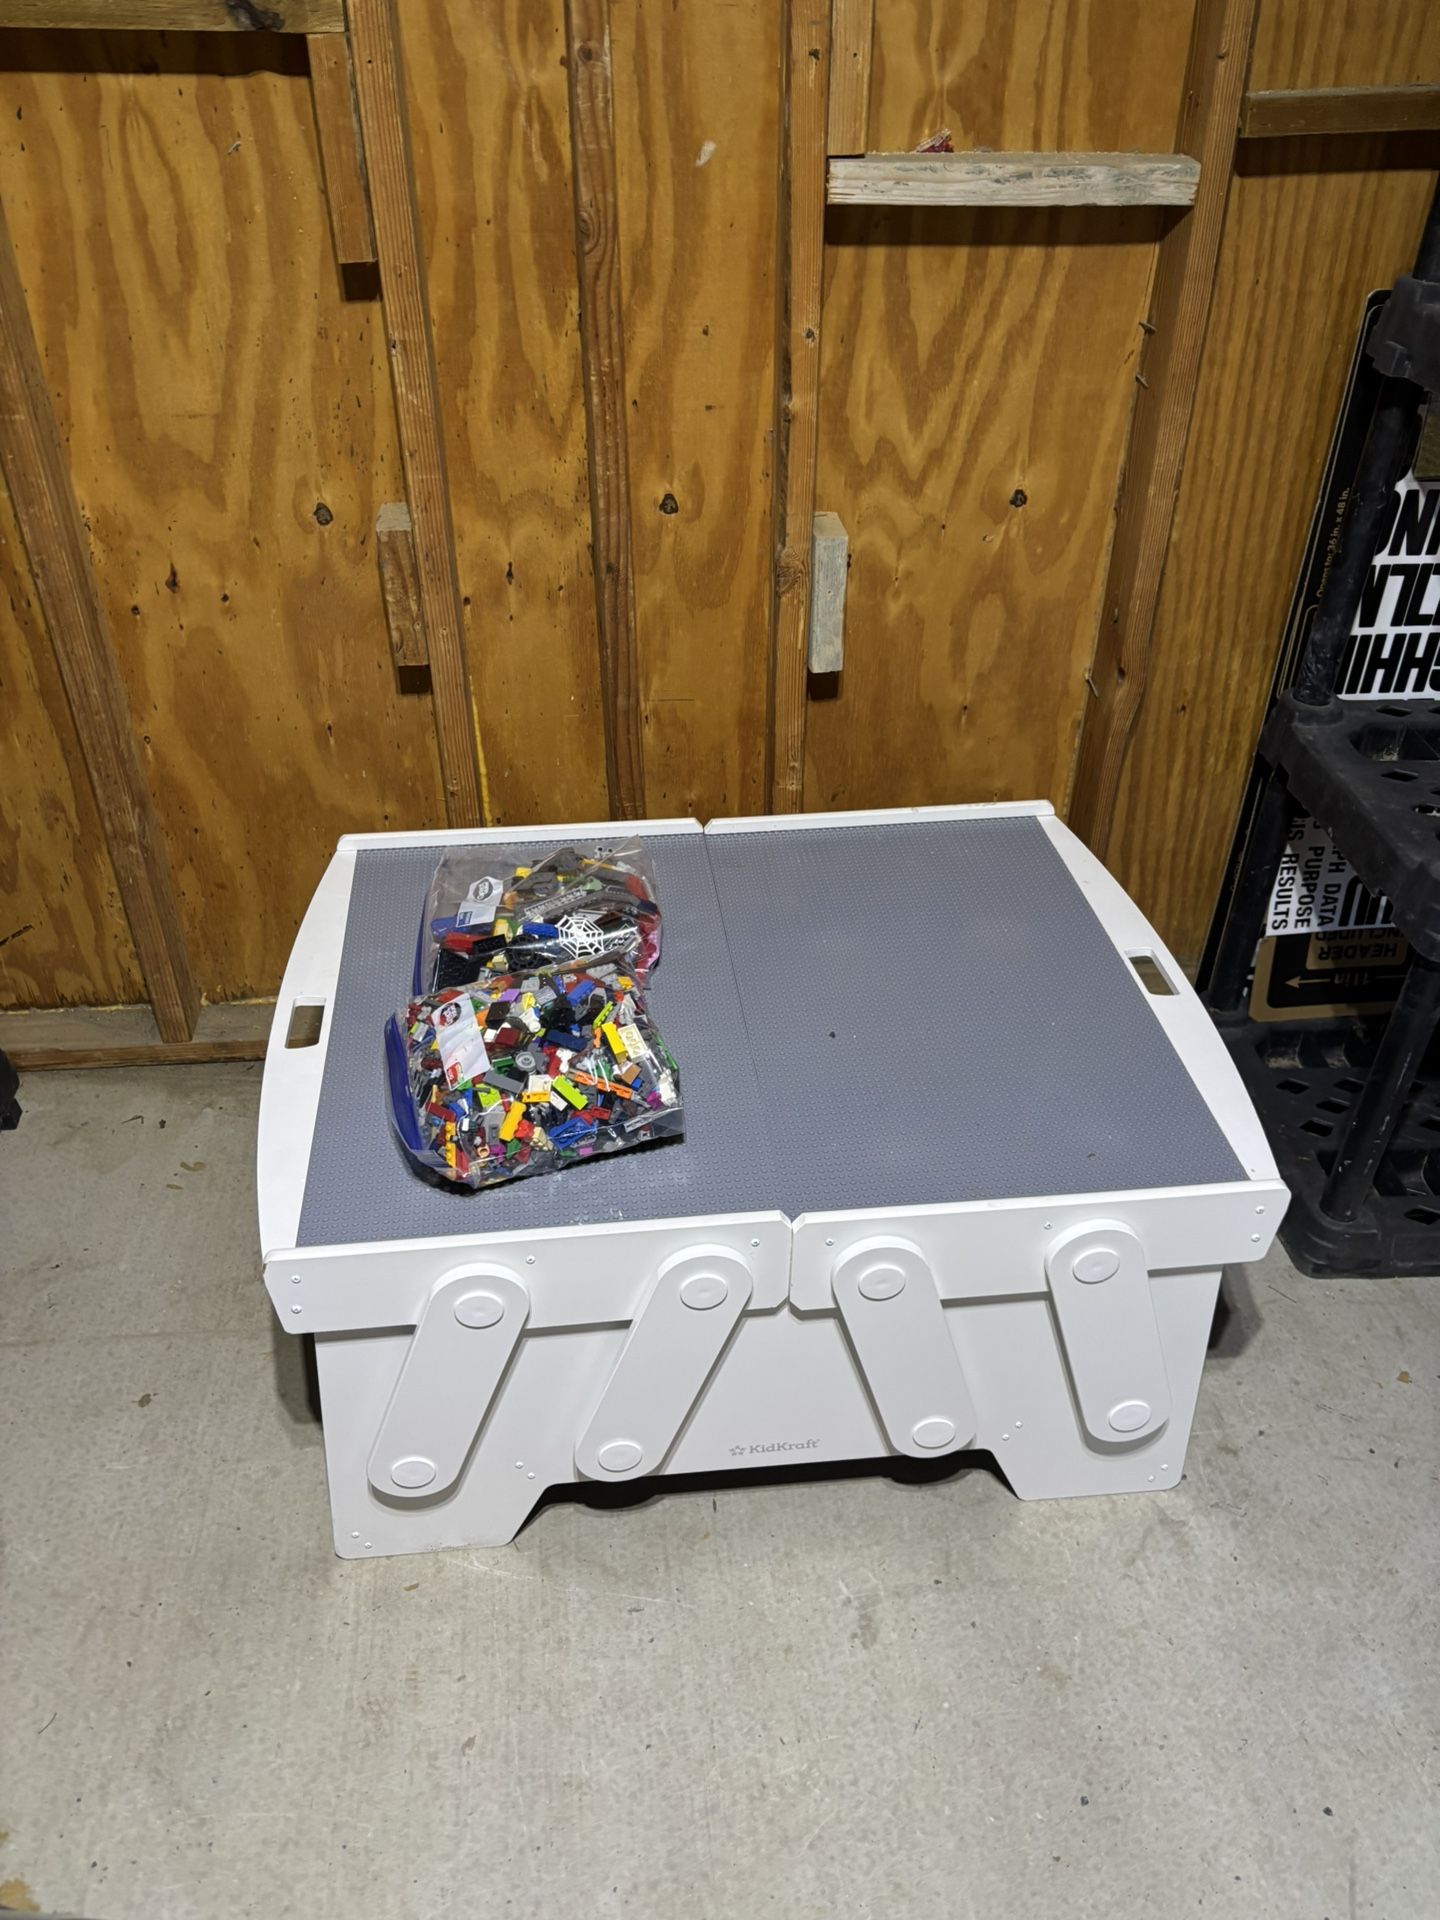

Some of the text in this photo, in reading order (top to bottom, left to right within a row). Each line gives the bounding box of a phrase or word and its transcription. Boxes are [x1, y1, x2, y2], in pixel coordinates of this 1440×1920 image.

[1339, 487, 1350, 500] in.
[1336, 501, 1346, 515] 48
[1271, 853, 1300, 930] RESULTS
[1294, 846, 1325, 928] PURPOSE
[1317, 883, 1342, 927] DATA
[1317, 943, 1397, 960] HEADER
[749, 1439, 818, 1454] KidKraft
